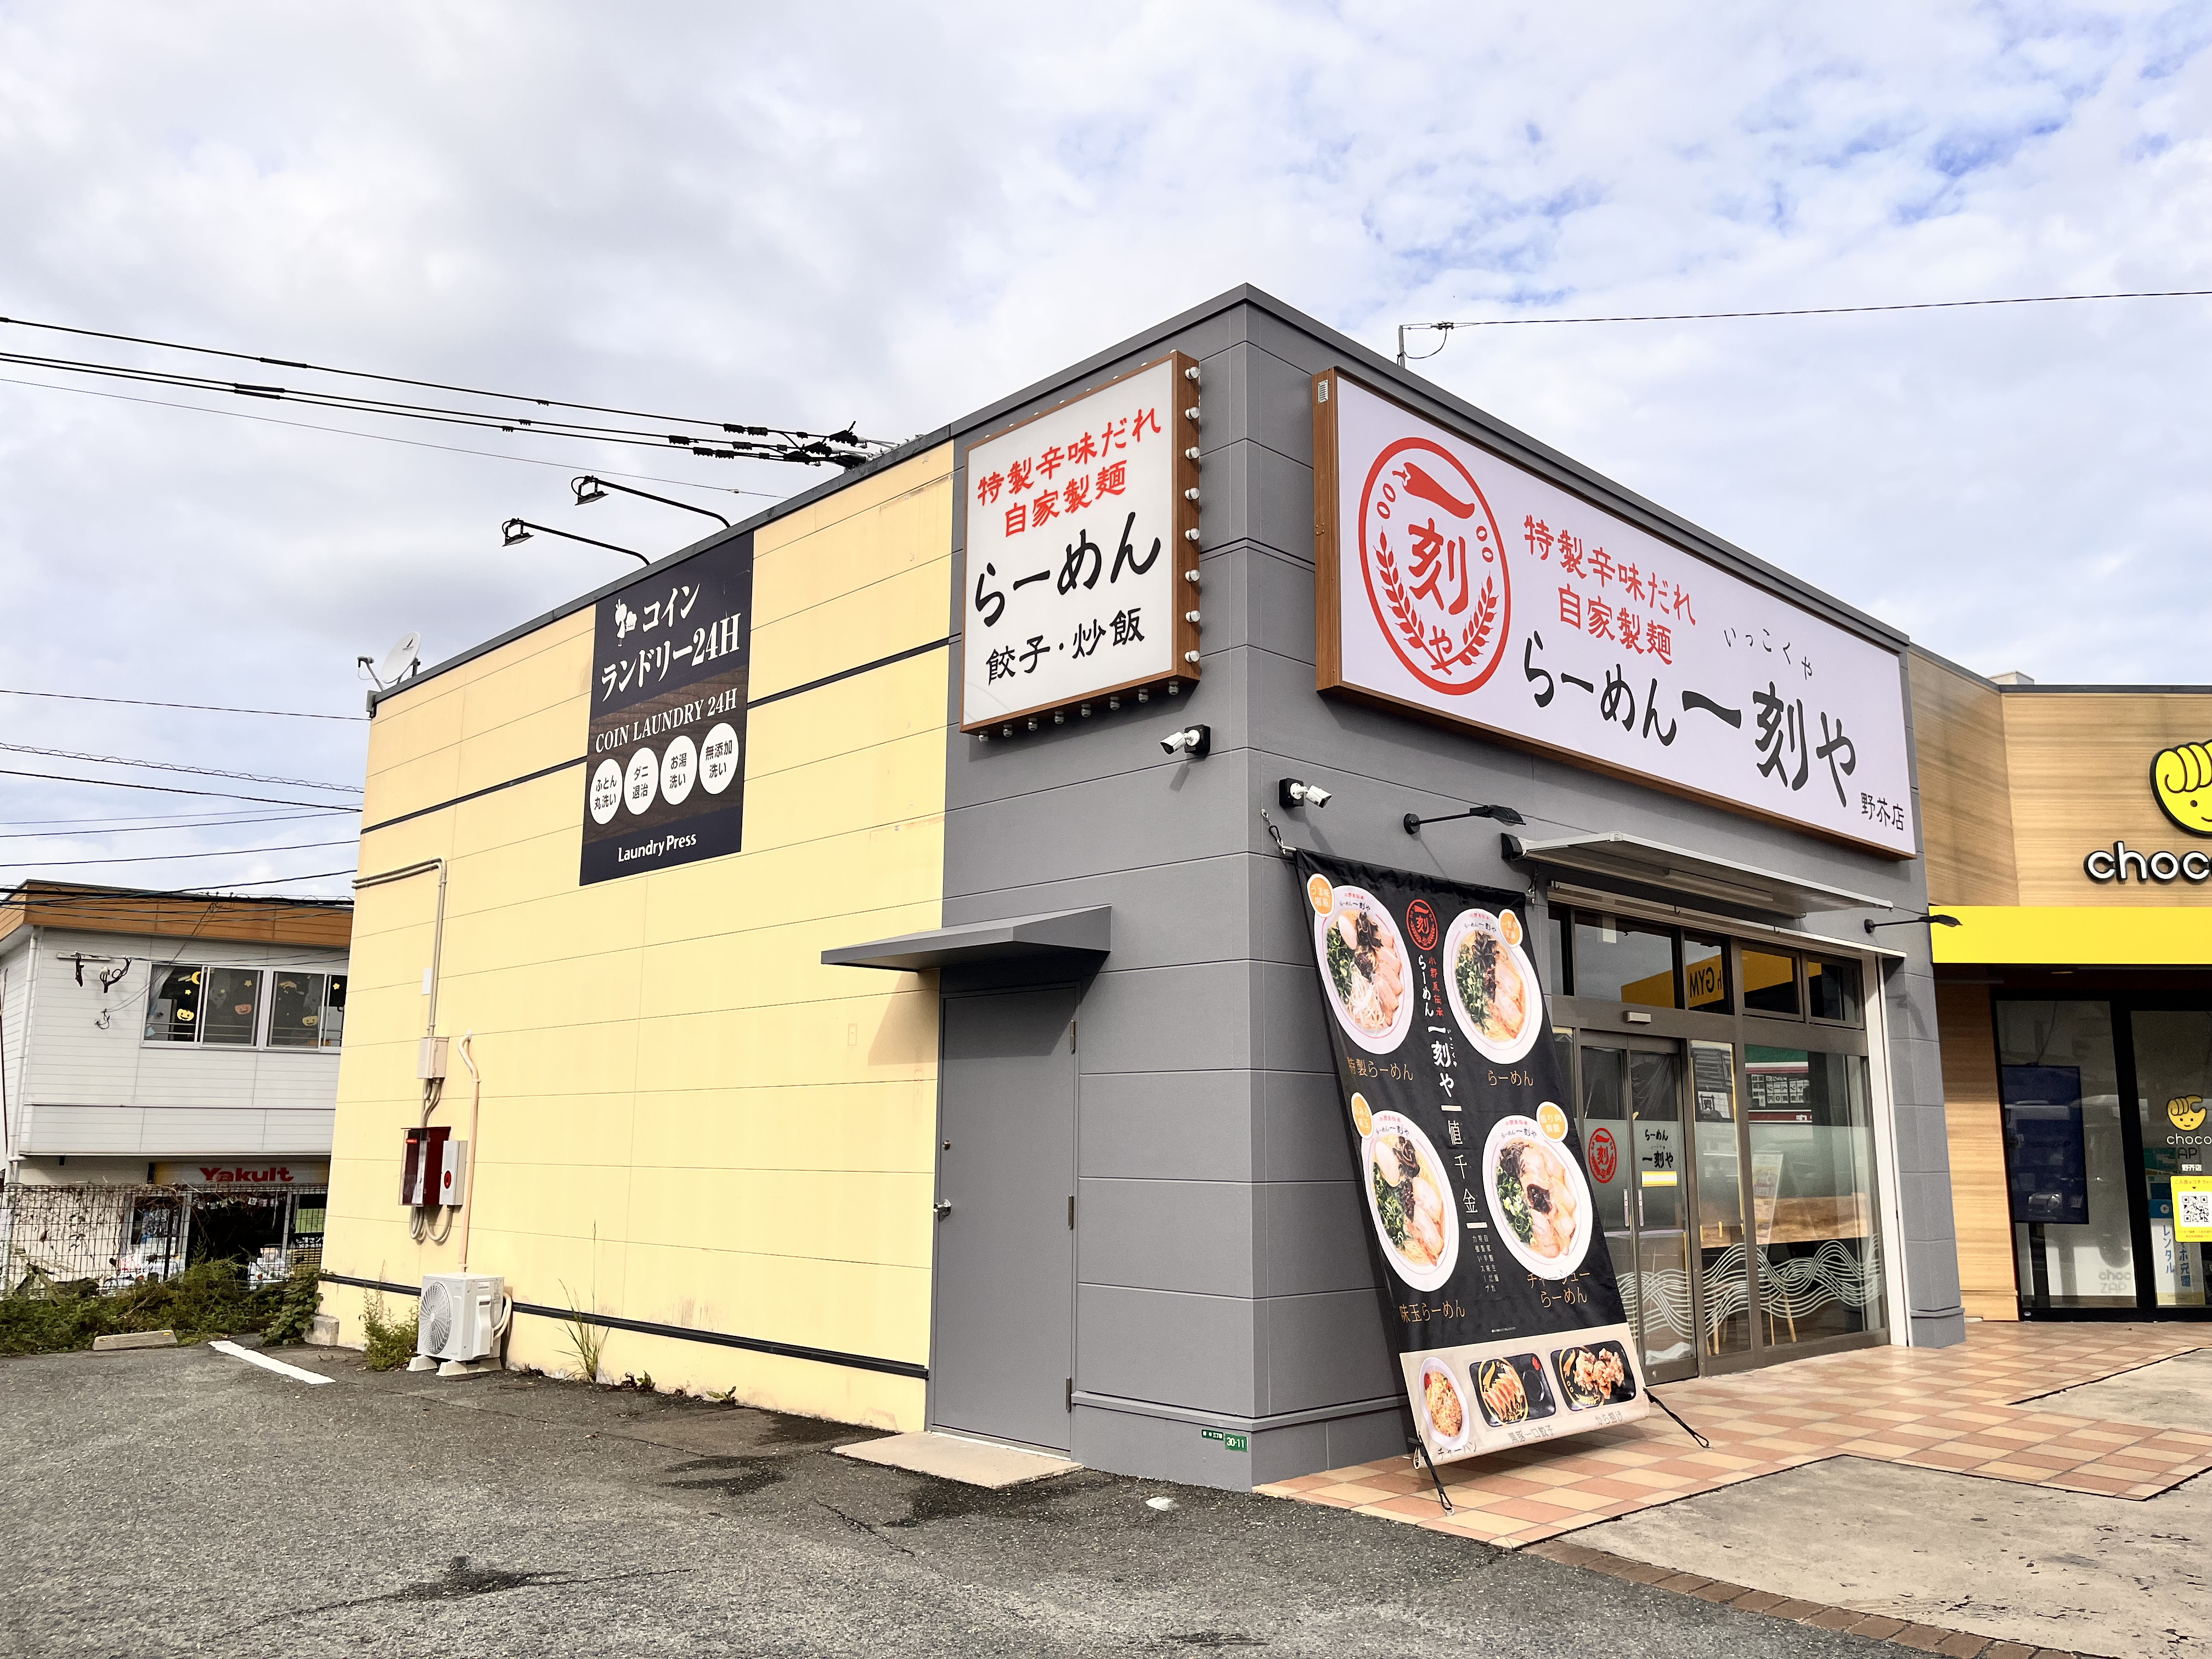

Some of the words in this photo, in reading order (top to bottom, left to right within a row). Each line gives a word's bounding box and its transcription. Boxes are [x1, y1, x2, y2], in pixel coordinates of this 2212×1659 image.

[978, 408, 1161, 506] 特製辛味だれ
[1005, 459, 1127, 537] 自家製麺
[974, 511, 1161, 628] らーめん
[1523, 514, 1696, 626] 特製辛味だれ
[643, 583, 701, 633] コイン
[1558, 583, 1672, 665] 自家製麺
[601, 612, 741, 702] ランドリー24H
[986, 607, 1145, 686] 餃子・炒飯
[1724, 628, 1813, 681] いっこくや
[595, 724, 629, 753] COIN
[633, 701, 703, 741] LAUNDRY
[707, 688, 738, 716] 24H
[670, 753, 687, 770] お湯
[706, 740, 732, 761] 無添加
[634, 766, 648, 781] ダニ
[669, 774, 686, 789] 洗い
[709, 762, 727, 779] 洗い
[596, 775, 617, 792] ふとん
[632, 783, 648, 800] 退治
[594, 794, 616, 810] 丸洗い
[1861, 792, 1904, 832] 野芥店
[618, 839, 665, 862] Laundry
[666, 833, 697, 851] Press
[2083, 840, 2212, 885] choc
[1418, 955, 1434, 1017] らーめん
[1346, 1056, 1413, 1081] 特製らーめん
[1427, 1025, 1454, 1097] 一刻や
[1487, 1070, 1534, 1087] らーめん
[1645, 1128, 1668, 1141] らーめん
[2166, 1132, 2212, 1145] choco
[1642, 1150, 1674, 1169] 一刻や
[200, 1167, 294, 1182] Yakult
[2163, 1224, 2175, 1274] レンタル
[1541, 1286, 1588, 1309] らーめん
[1398, 1300, 1466, 1323] 味玉らーめん
[1226, 1436, 1244, 1448] 30-11
[1437, 1441, 1477, 1460] チャーハン
